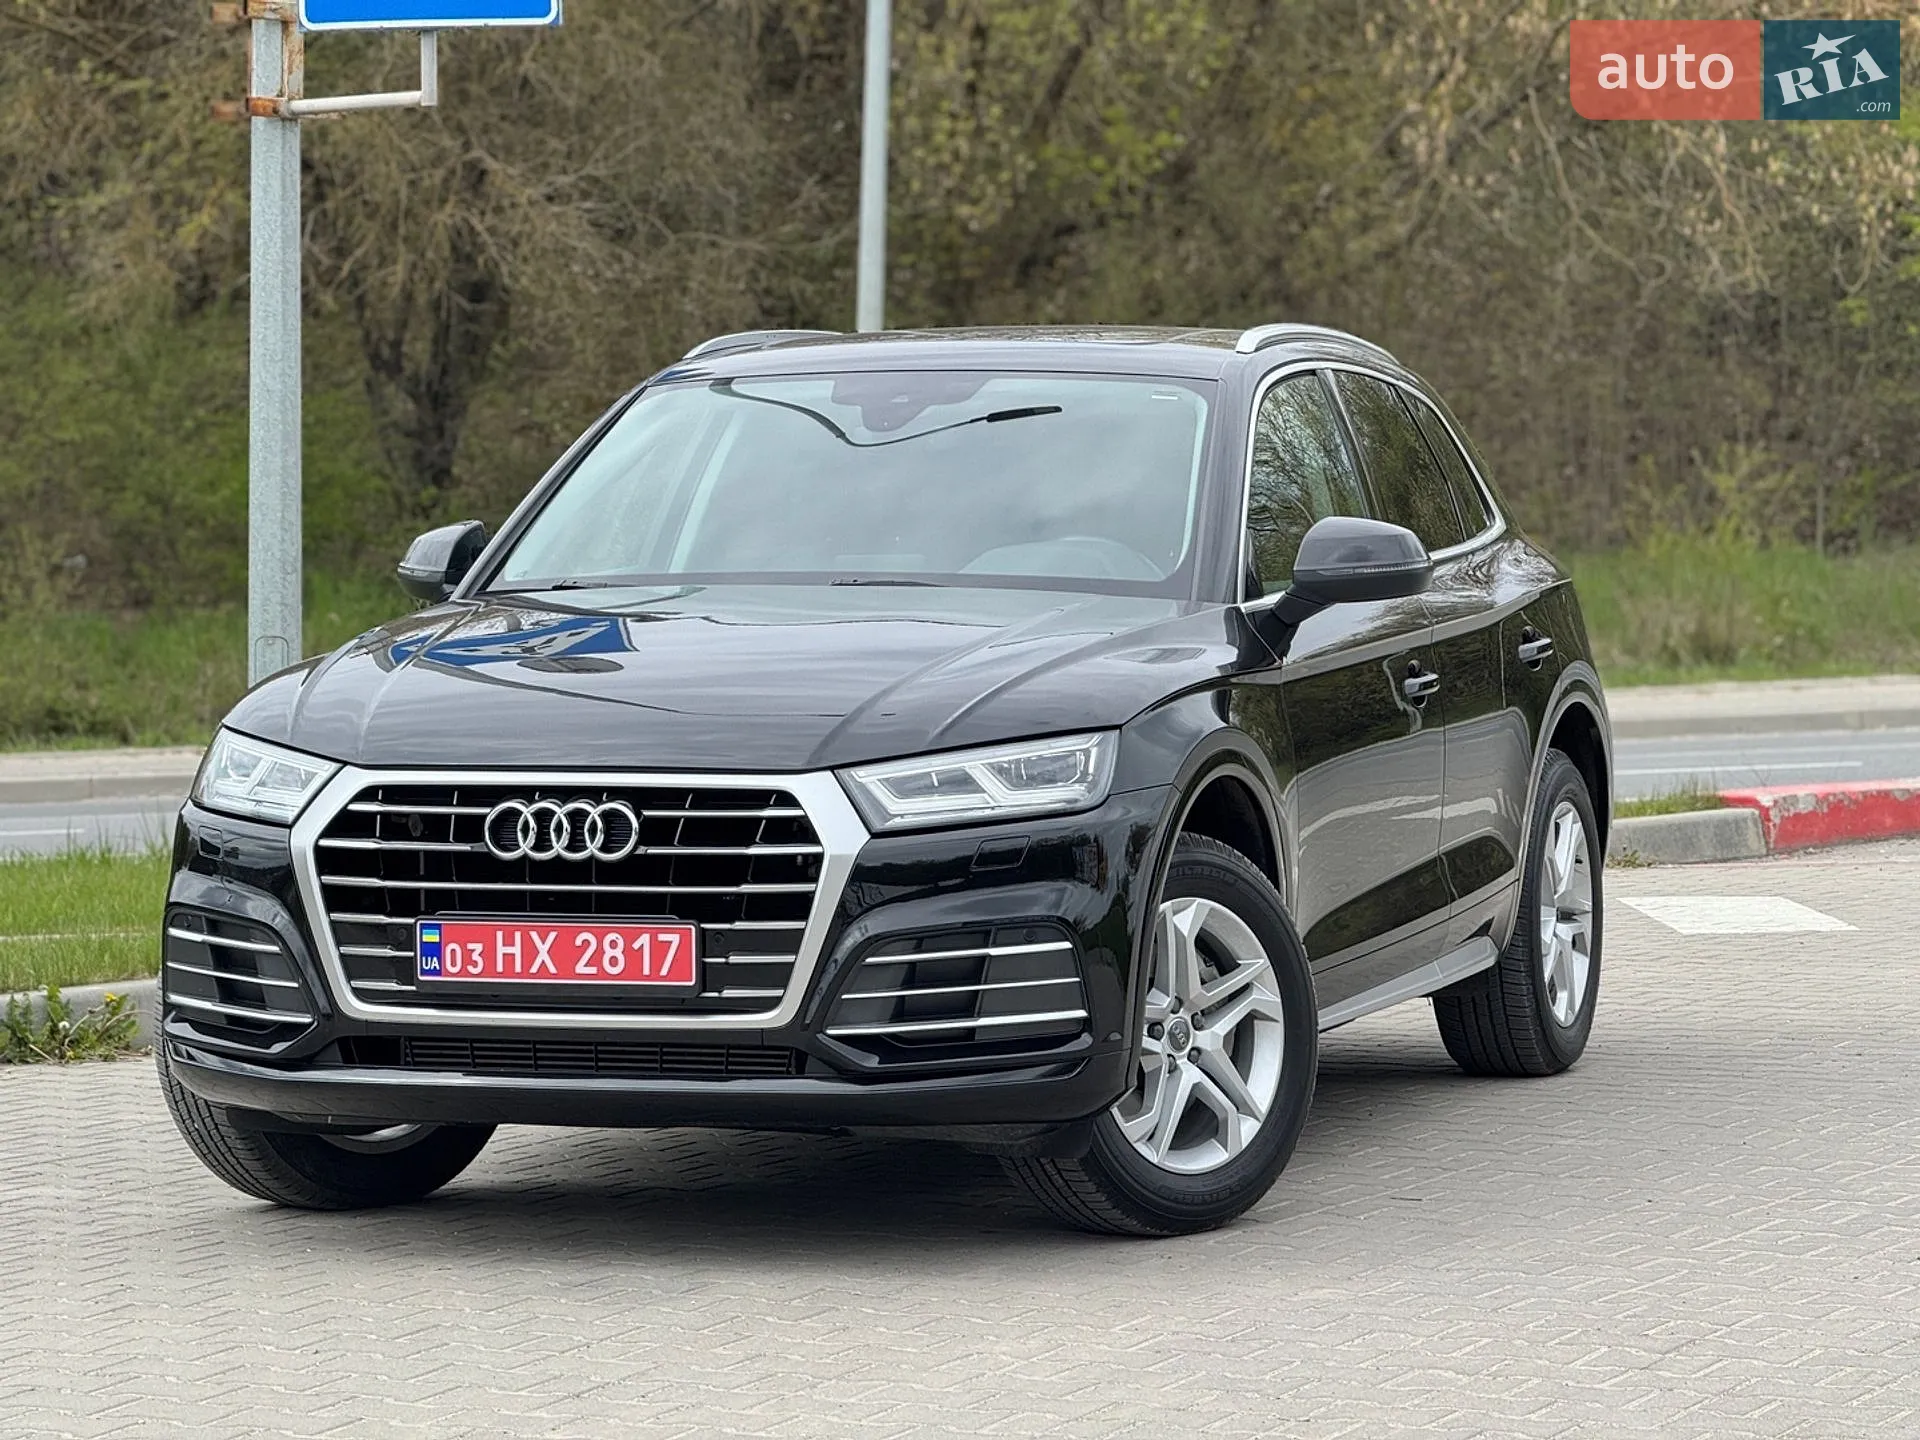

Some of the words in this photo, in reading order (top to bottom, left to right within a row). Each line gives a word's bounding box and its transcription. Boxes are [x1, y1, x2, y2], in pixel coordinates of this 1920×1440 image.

[422, 956, 440, 970] UA
[445, 943, 484, 975] 03
[495, 930, 558, 975] HX
[574, 931, 681, 977] 2817
